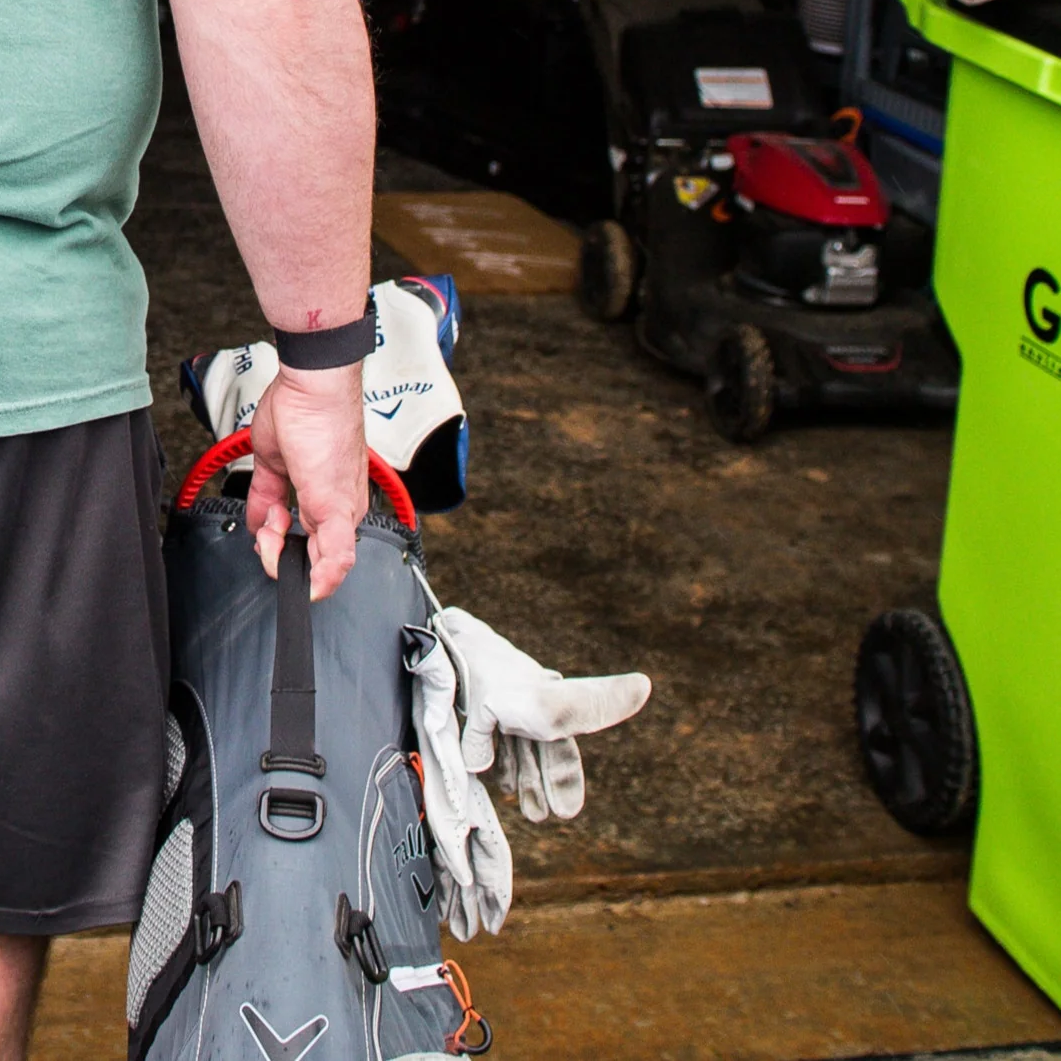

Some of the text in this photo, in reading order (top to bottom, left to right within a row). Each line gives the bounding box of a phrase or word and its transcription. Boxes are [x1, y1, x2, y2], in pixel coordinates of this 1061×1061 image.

[307, 308, 323, 329] K
[233, 343, 253, 376] THA
[363, 382, 434, 405] llaway
